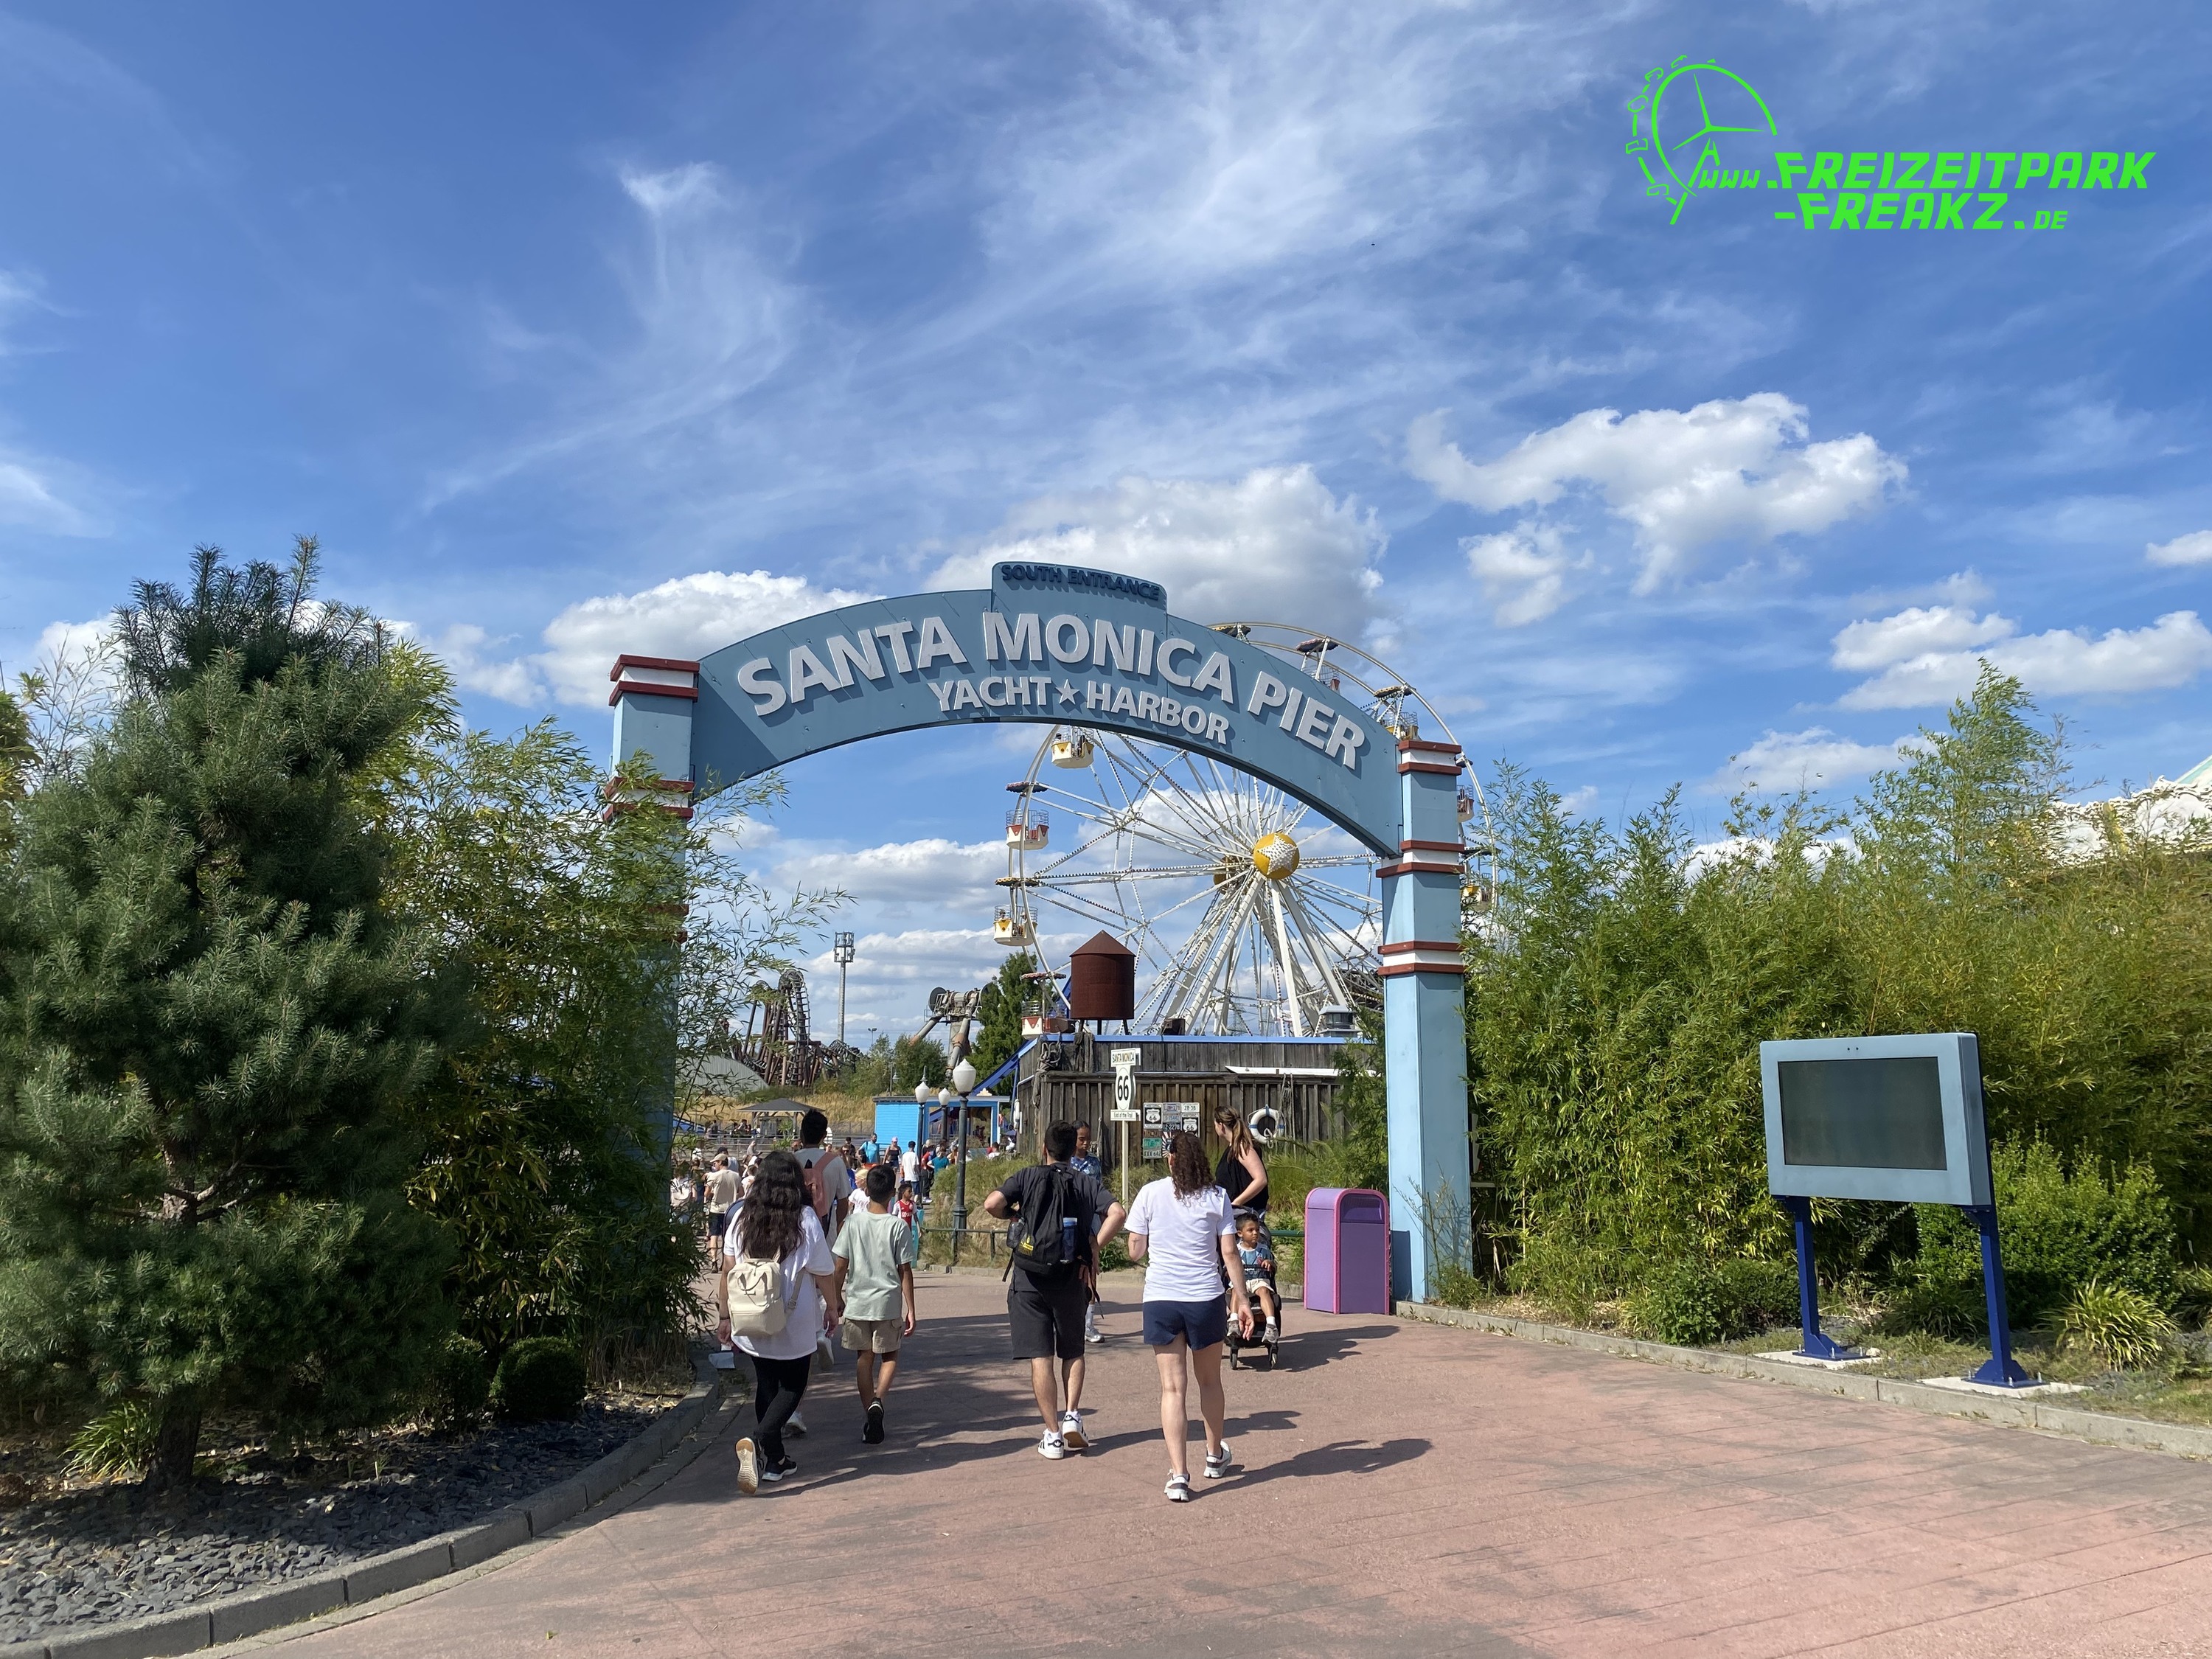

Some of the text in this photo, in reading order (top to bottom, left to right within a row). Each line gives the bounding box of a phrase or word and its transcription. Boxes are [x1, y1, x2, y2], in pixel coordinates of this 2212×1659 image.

[1001, 565, 1159, 600] SOUTH ENTRANCE
[738, 611, 1366, 771] SANTA MONICA PIER
[928, 676, 1229, 745] YACHT HARBOR
[1113, 1053, 1121, 1062] SANTA
[1118, 1076, 1129, 1101] 66
